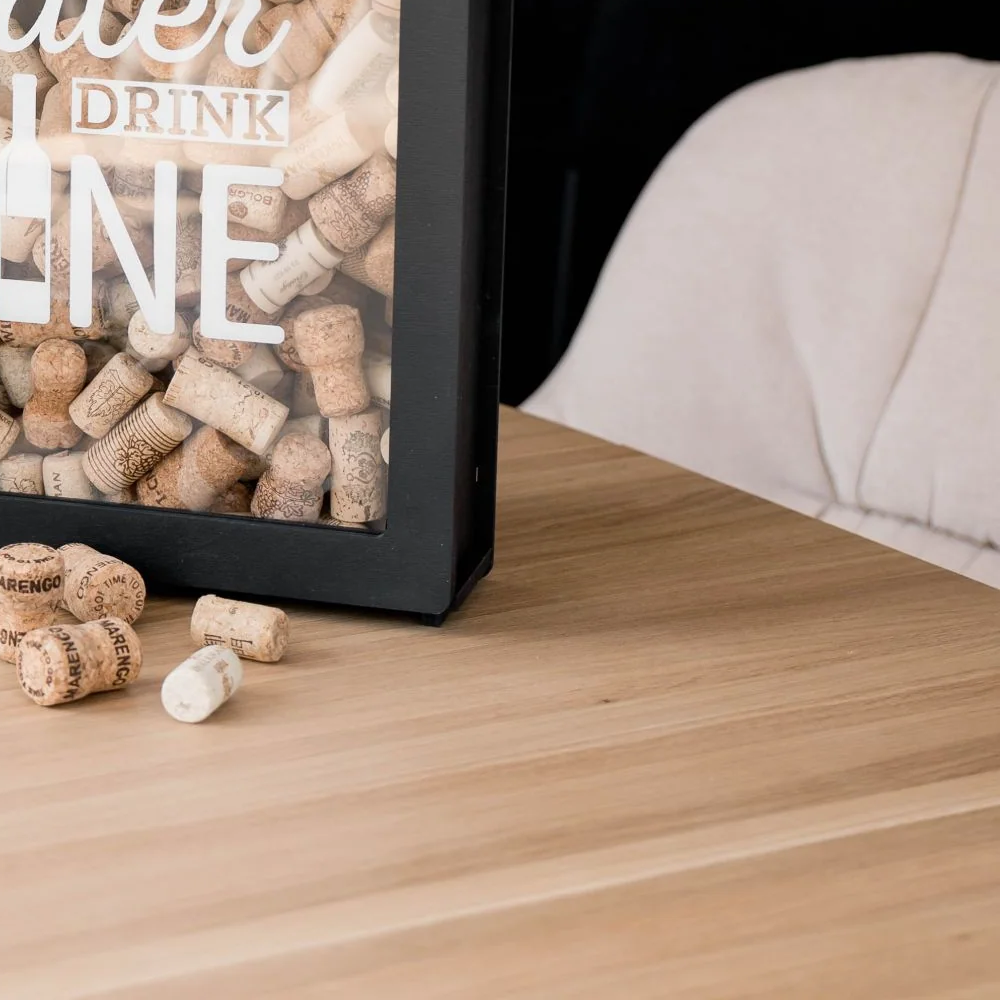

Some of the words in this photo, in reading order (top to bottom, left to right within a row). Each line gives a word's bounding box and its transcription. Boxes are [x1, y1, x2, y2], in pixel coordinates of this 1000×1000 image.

[74, 82, 286, 142] DRINK
[103, 574, 127, 589] TIME
[128, 576, 141, 590] TO
[49, 626, 83, 699] MARENGO
[101, 618, 132, 687] MARENGO
